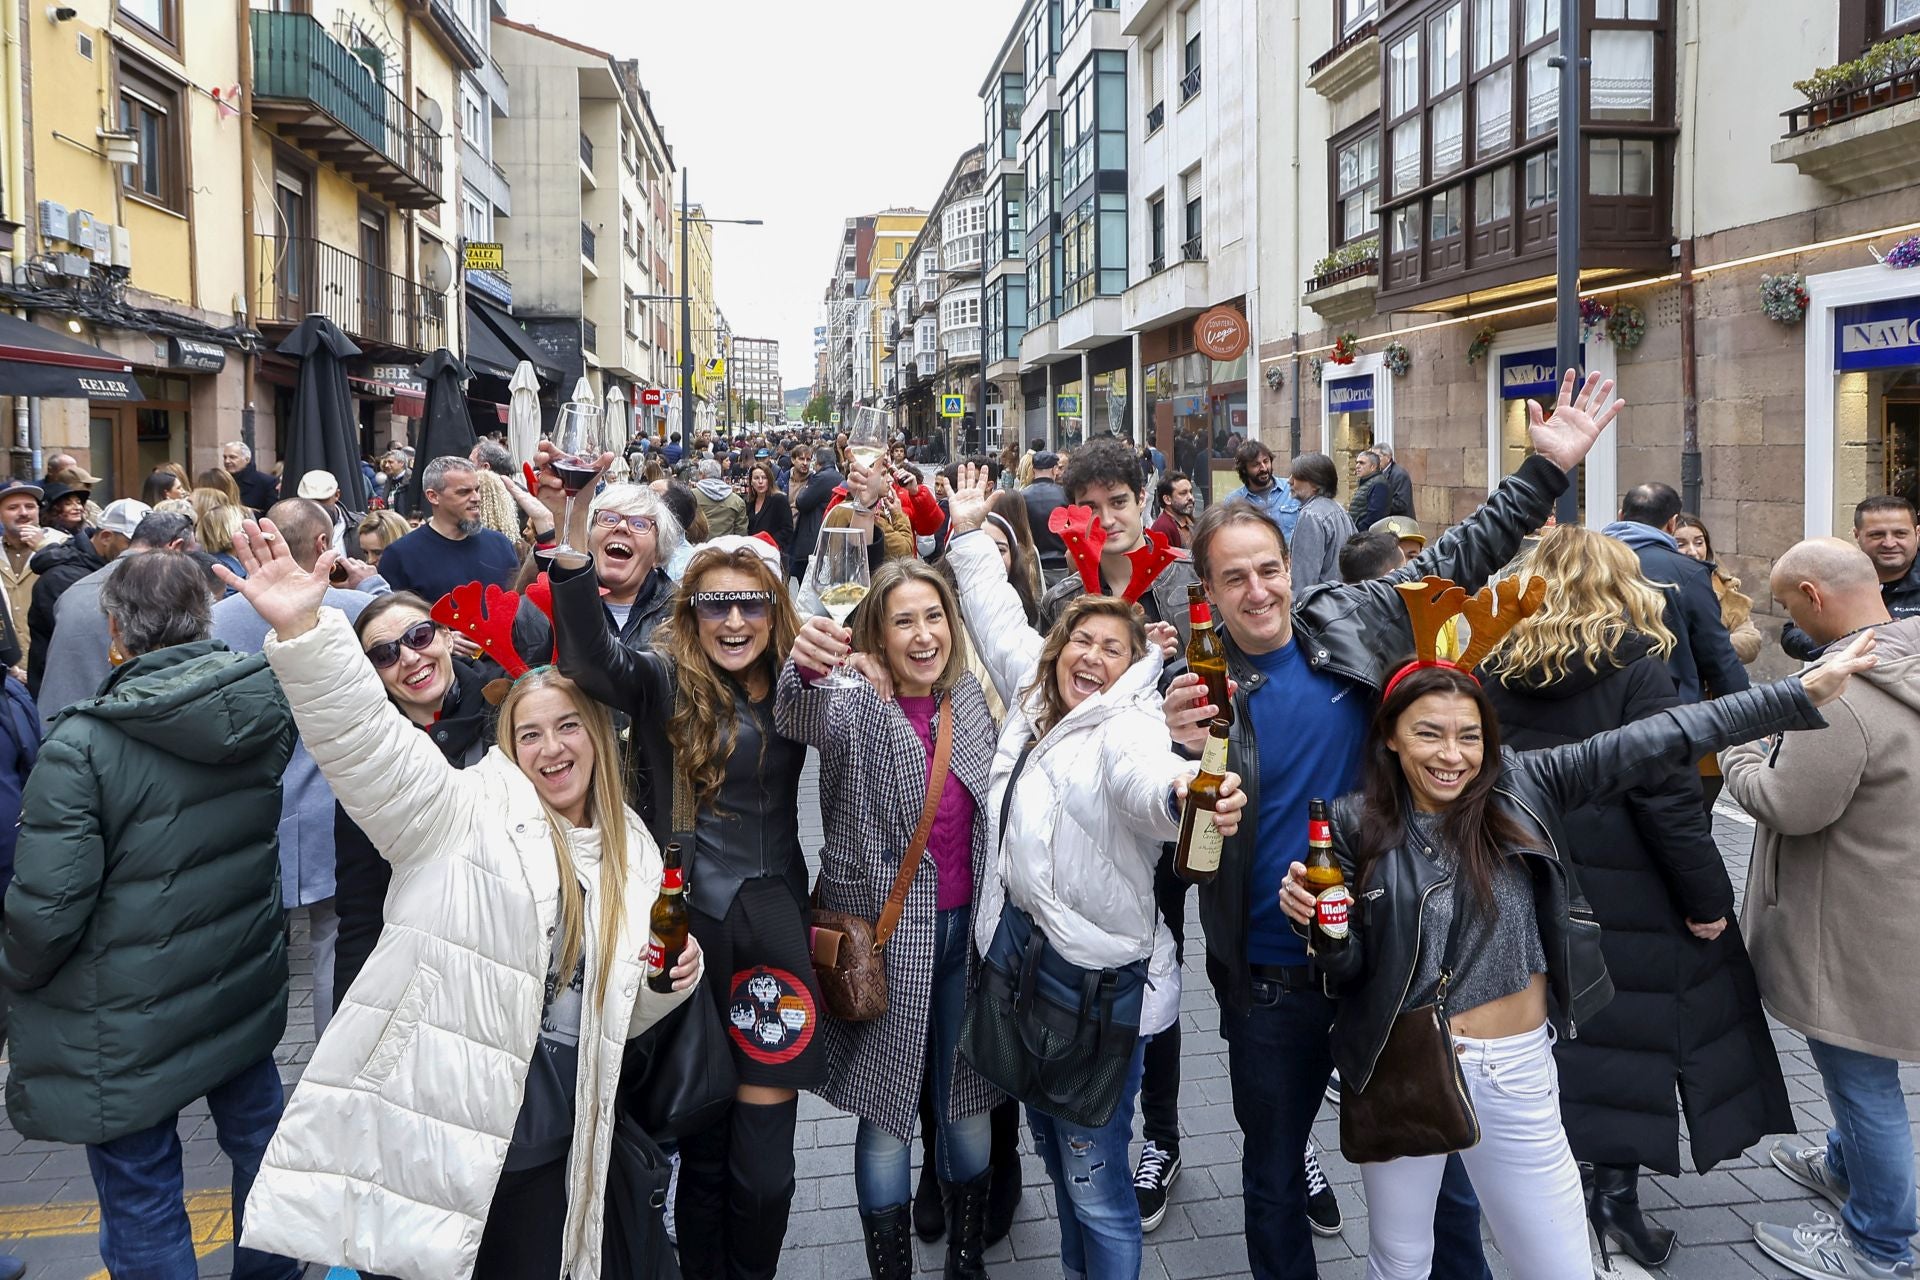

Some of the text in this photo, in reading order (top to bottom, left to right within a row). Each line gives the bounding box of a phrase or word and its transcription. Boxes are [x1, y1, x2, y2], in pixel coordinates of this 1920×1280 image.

[465, 261, 500, 269] AMARIA
[77, 377, 130, 393] KELER
[698, 591, 770, 602] DOLCE&GABBANA
[1817, 1248, 1849, 1275] N
